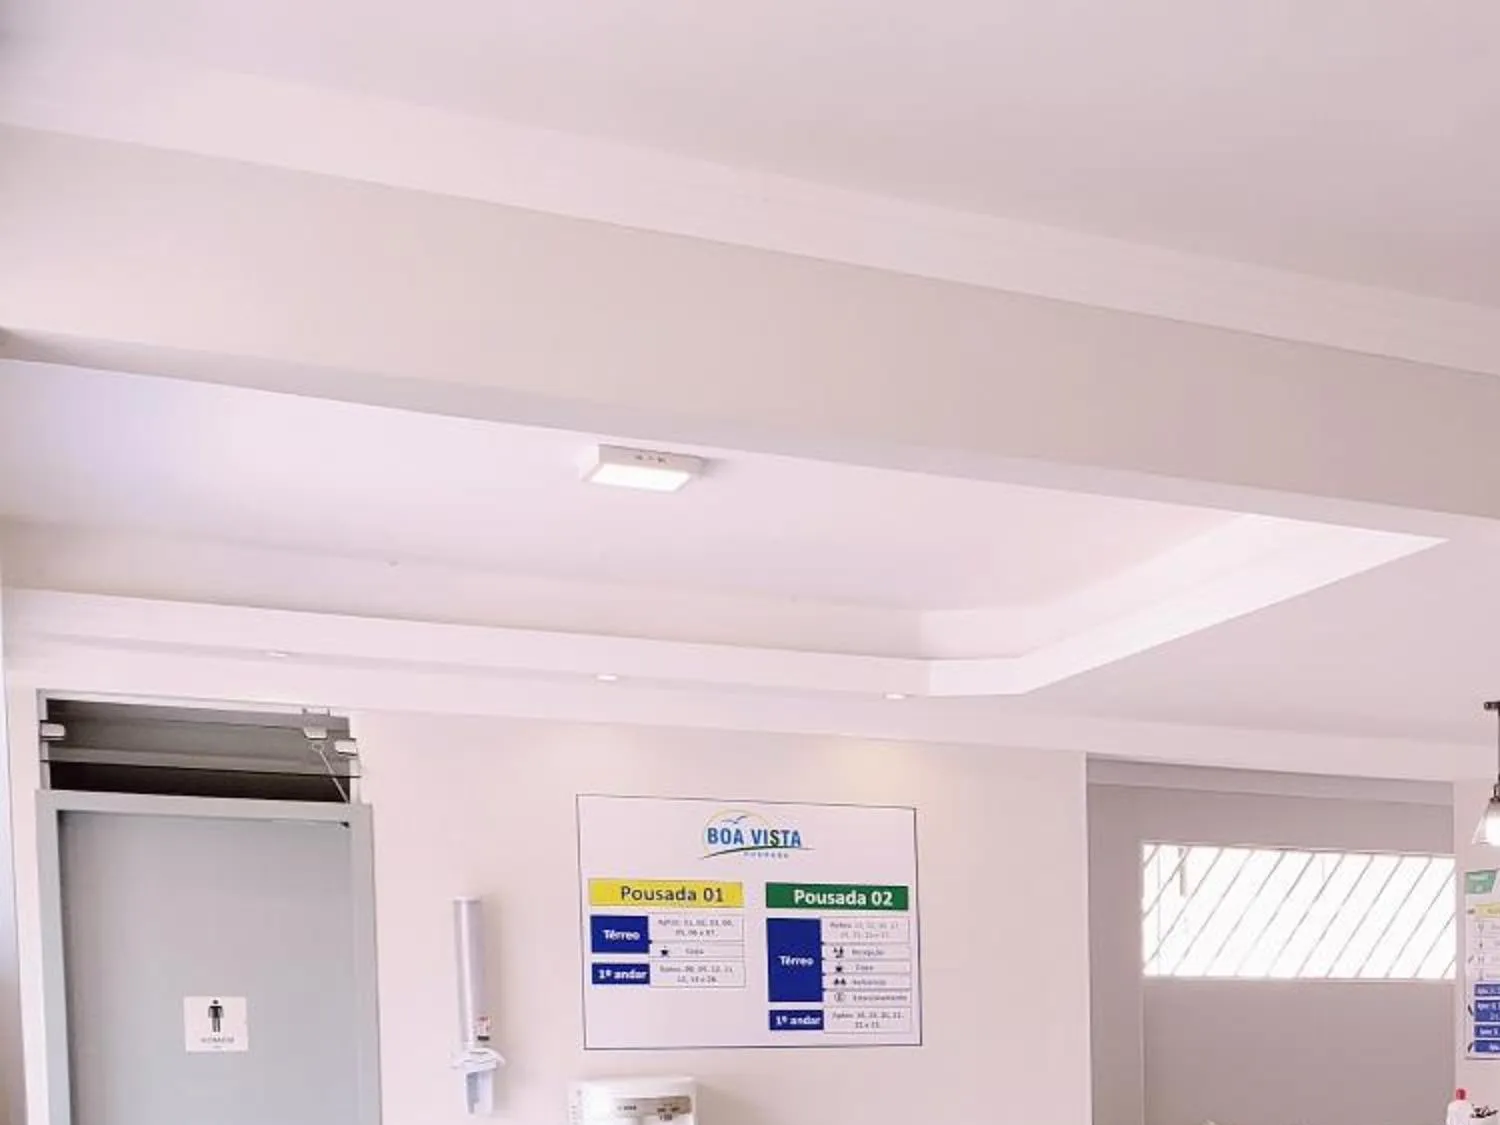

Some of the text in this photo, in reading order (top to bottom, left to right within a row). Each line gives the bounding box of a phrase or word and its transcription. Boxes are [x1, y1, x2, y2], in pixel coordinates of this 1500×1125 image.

[707, 827, 802, 849] BOA VISTA
[620, 885, 725, 903] Pousada 01
[794, 889, 893, 907] Pousada 02
[603, 928, 641, 941] Térreo
[779, 954, 815, 967] Térreo
[613, 968, 648, 980] andar
[789, 1015, 822, 1026] andar
